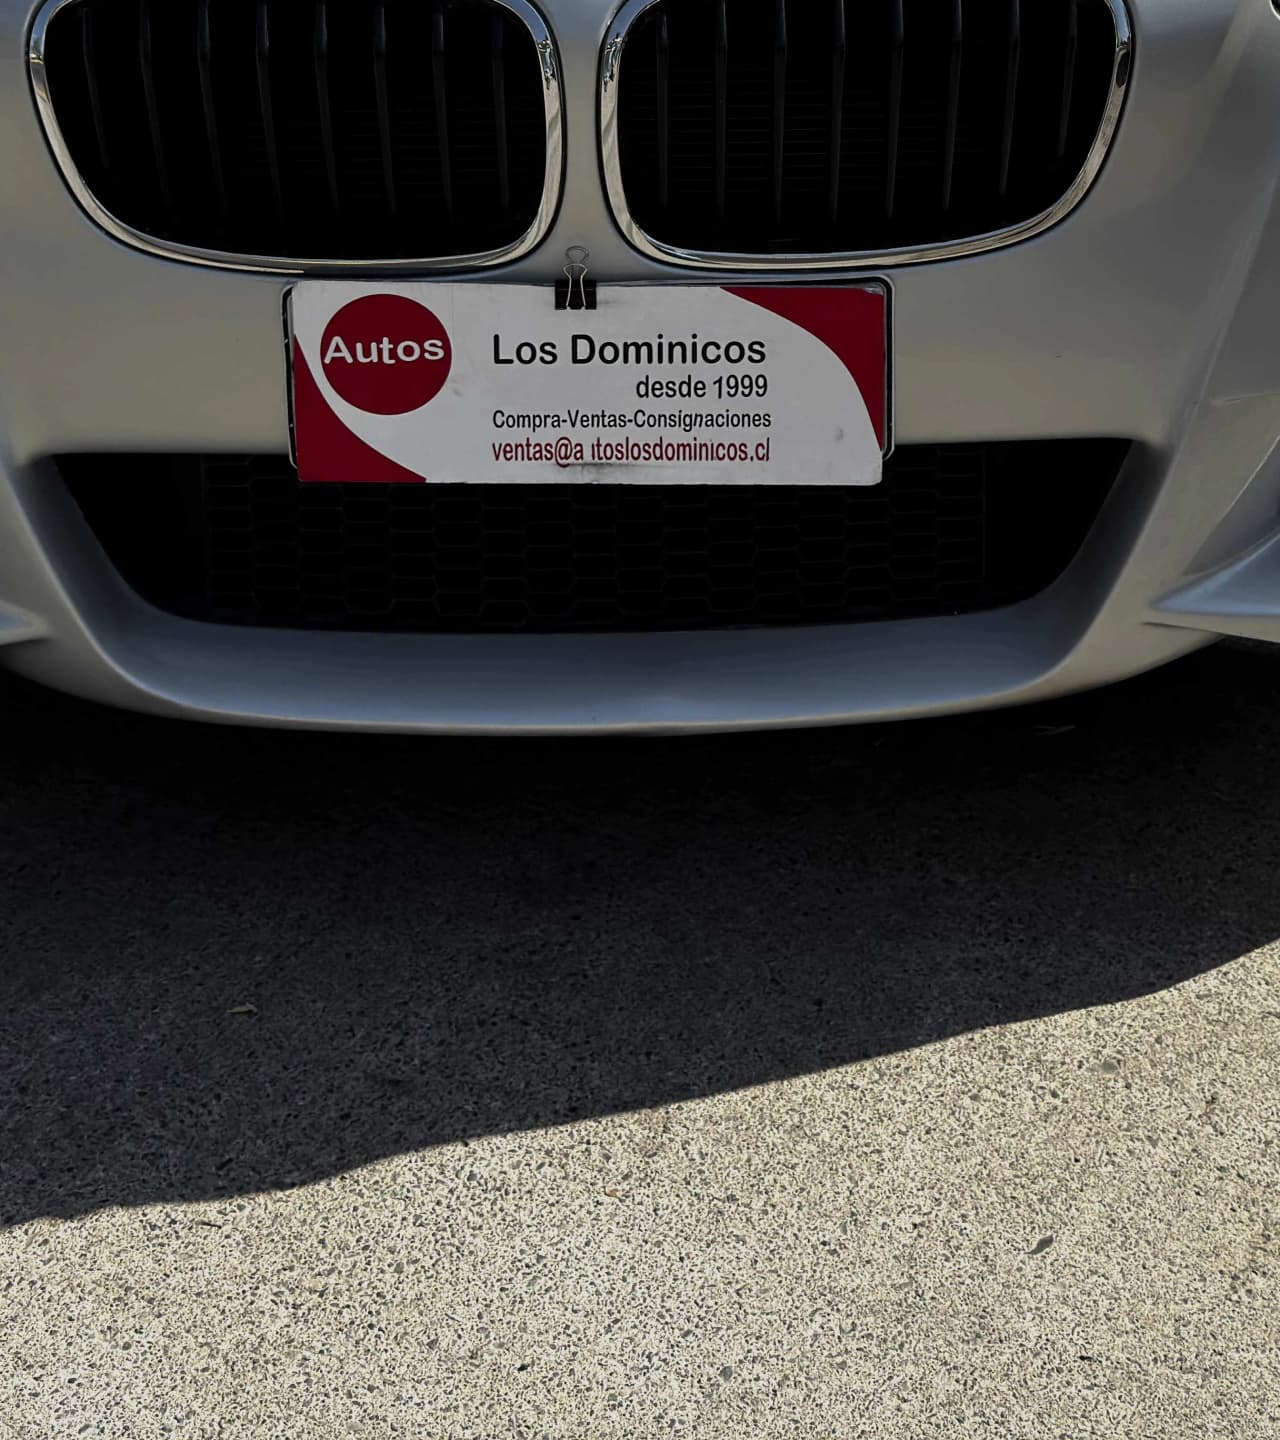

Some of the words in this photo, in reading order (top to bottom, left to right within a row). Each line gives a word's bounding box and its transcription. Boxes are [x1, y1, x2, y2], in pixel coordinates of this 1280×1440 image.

[324, 336, 445, 364] Autos
[492, 334, 558, 365] Los
[571, 333, 766, 365] Dominicos
[636, 374, 706, 399] desde
[712, 374, 768, 399] 1999
[492, 409, 771, 432] Compra-Ventas-Consignaciones
